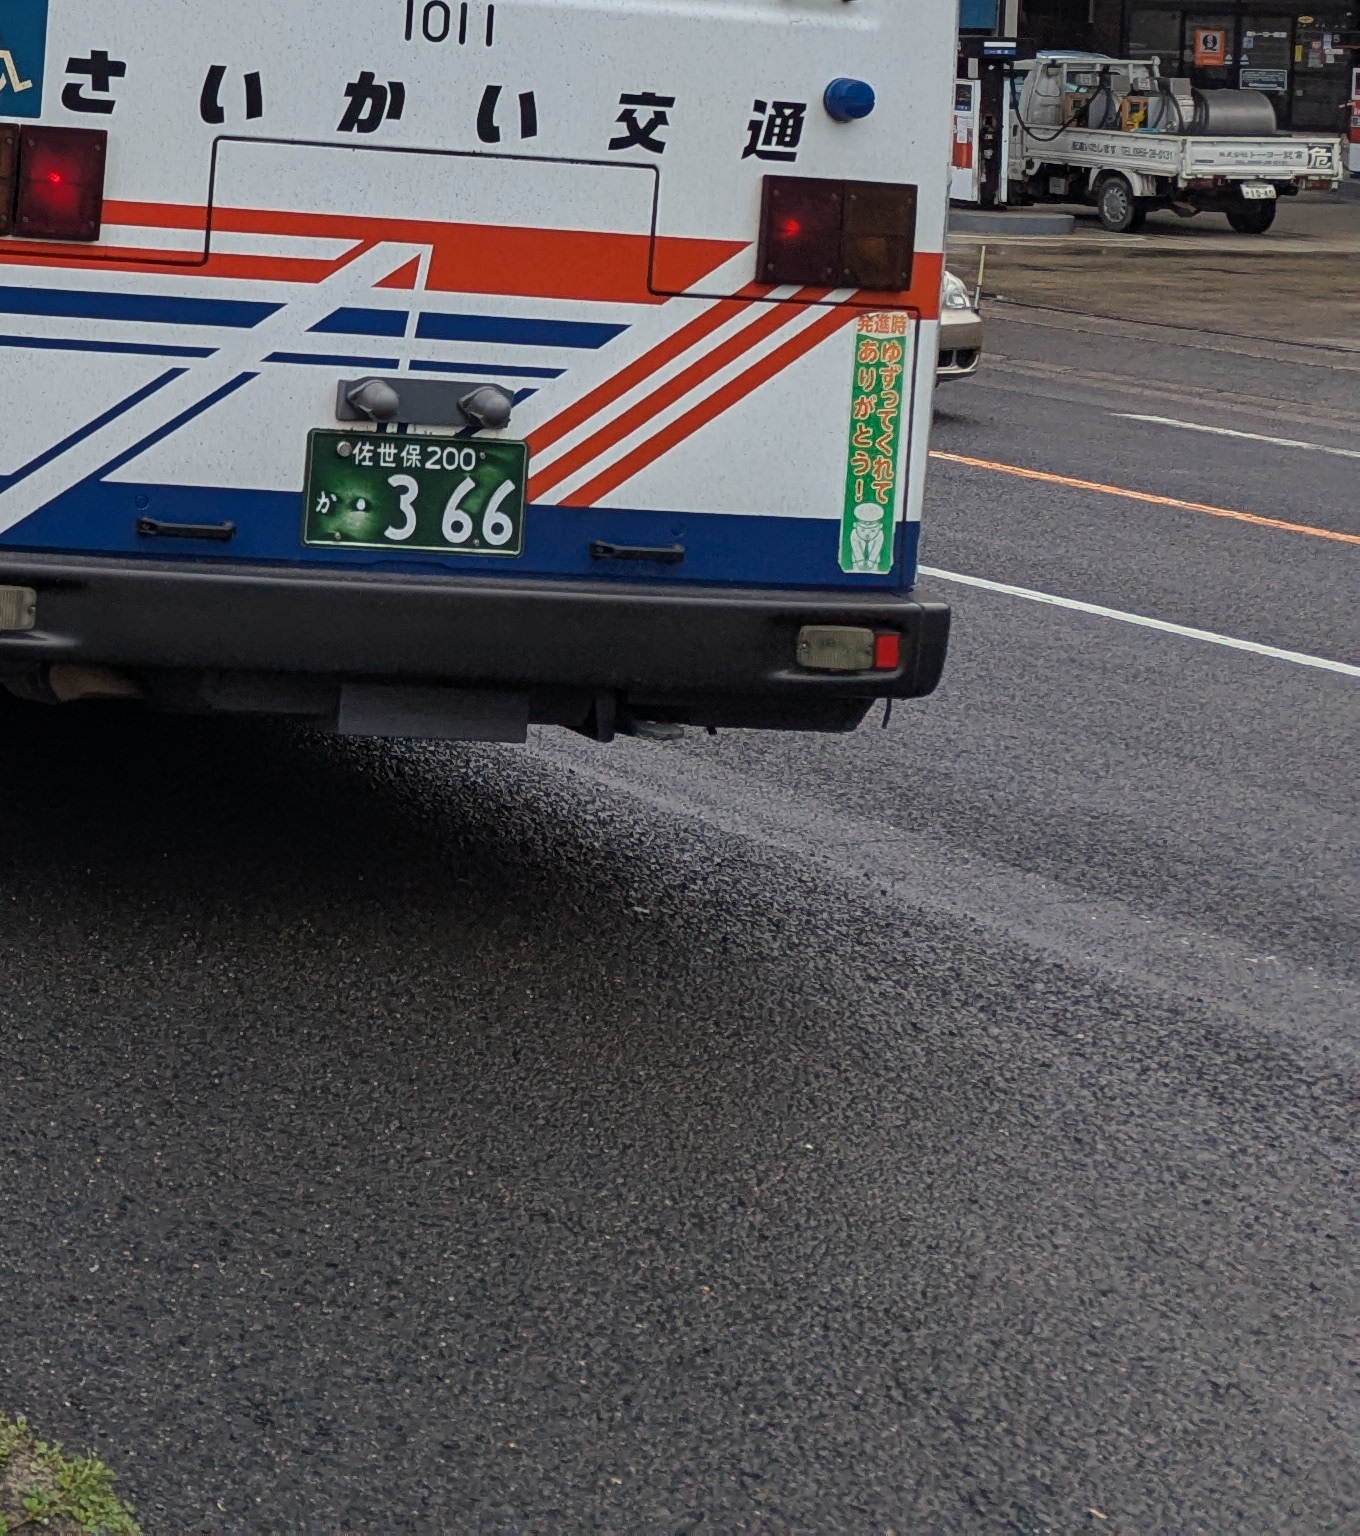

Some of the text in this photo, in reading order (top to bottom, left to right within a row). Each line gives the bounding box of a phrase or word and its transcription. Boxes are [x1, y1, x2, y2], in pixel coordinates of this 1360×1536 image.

[60, 49, 807, 163] さいかい交通
[1308, 146, 1332, 168] 危
[856, 314, 908, 335] 発進時
[870, 339, 902, 504] ゆずってくれて
[352, 440, 476, 471] 佐世保200
[315, 490, 338, 514] か
